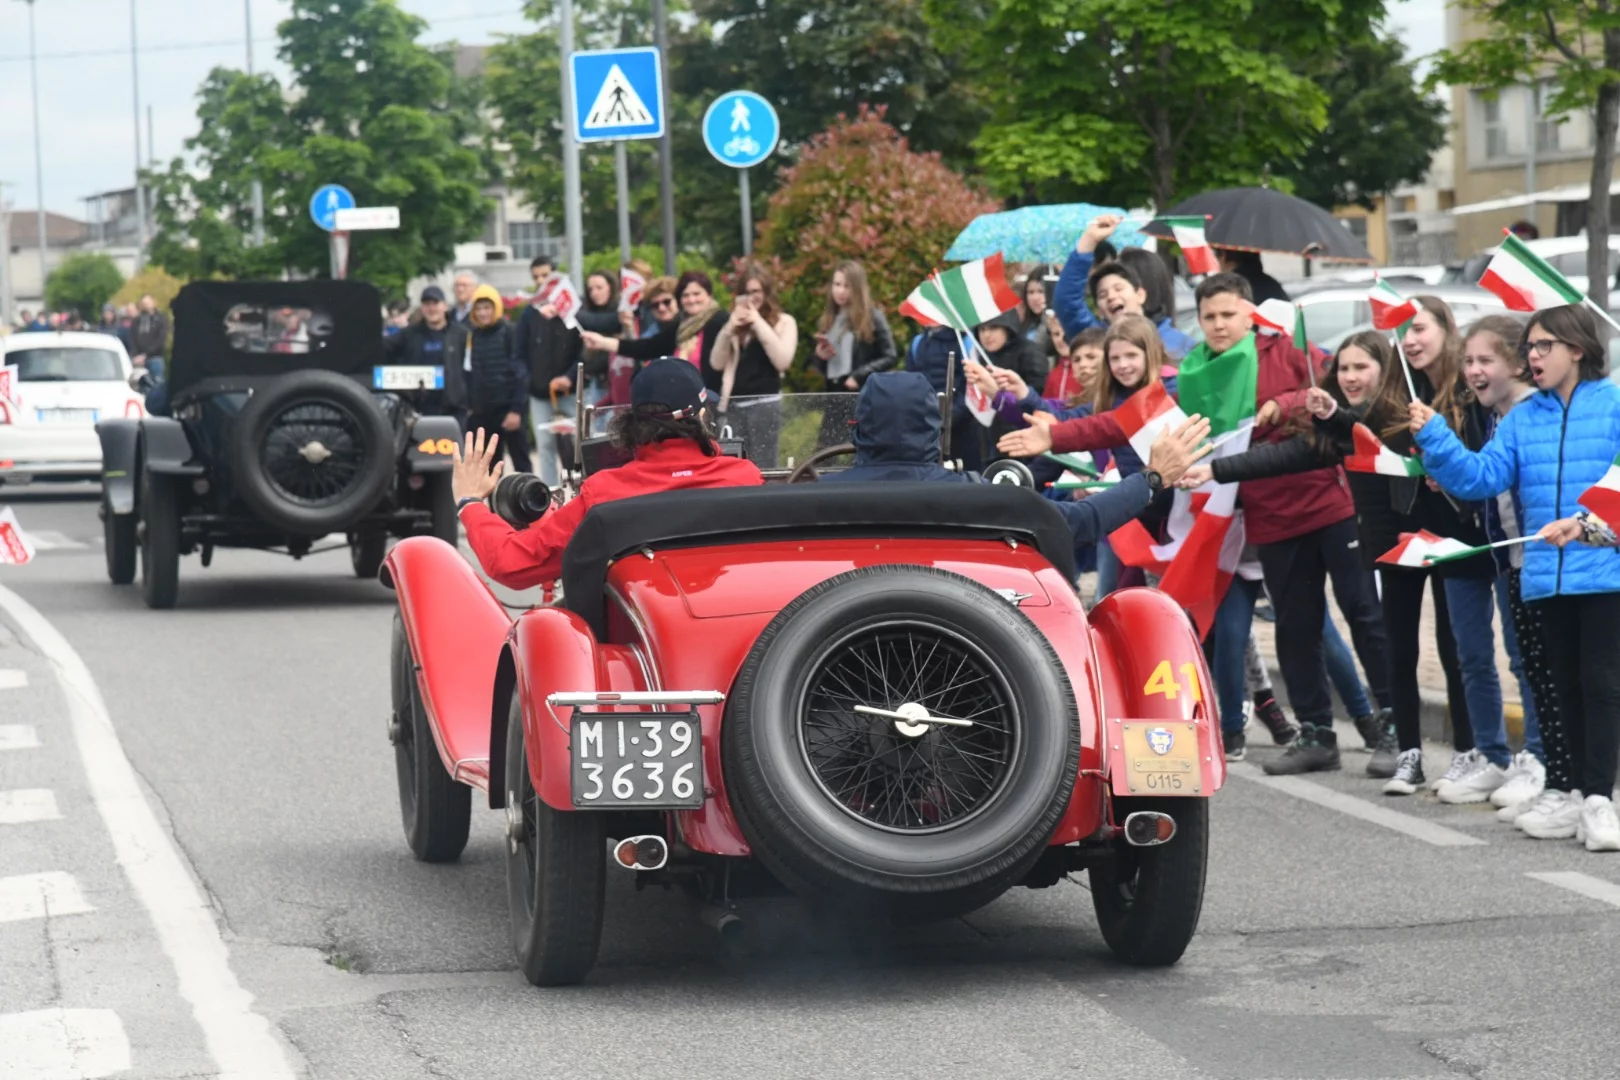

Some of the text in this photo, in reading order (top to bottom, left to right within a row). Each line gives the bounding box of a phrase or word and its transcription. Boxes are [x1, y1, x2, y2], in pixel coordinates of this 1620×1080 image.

[418, 438, 454, 455] 40
[1143, 660, 1202, 701] 41
[581, 762, 694, 800] 3636
[1146, 773, 1182, 789] 0115
